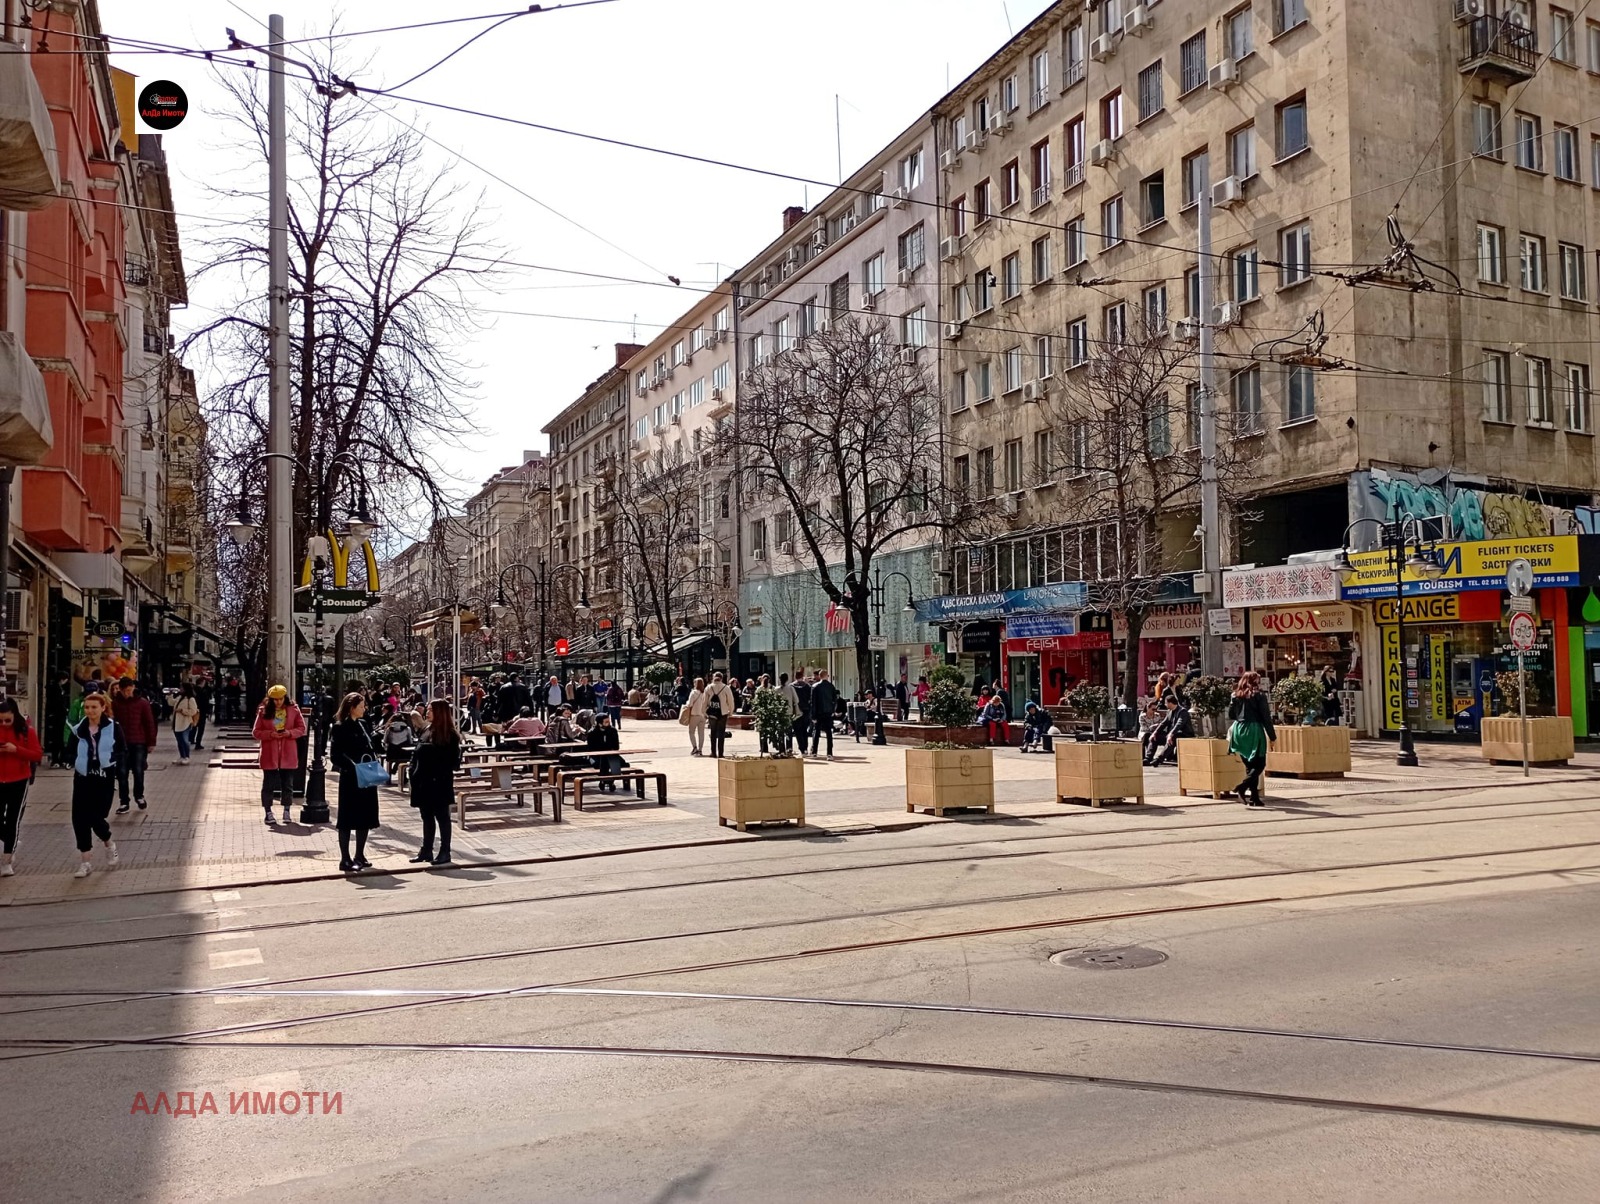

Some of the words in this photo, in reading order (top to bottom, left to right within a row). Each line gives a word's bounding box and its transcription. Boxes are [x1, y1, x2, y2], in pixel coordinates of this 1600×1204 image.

[1478, 546, 1511, 556] FLIGHT
[1513, 543, 1555, 554] TICKETS
[1418, 580, 1463, 591] TOURISM
[1379, 597, 1456, 620] CHANGE
[1140, 619, 1162, 631] OSE
[1267, 610, 1320, 633] ROSA
[1320, 620, 1334, 628] Oils
[1336, 618, 1344, 626] &
[1026, 638, 1060, 651] FETISH
[1388, 630, 1401, 725] CHANGE
[1434, 645, 1444, 716] CHANGE
